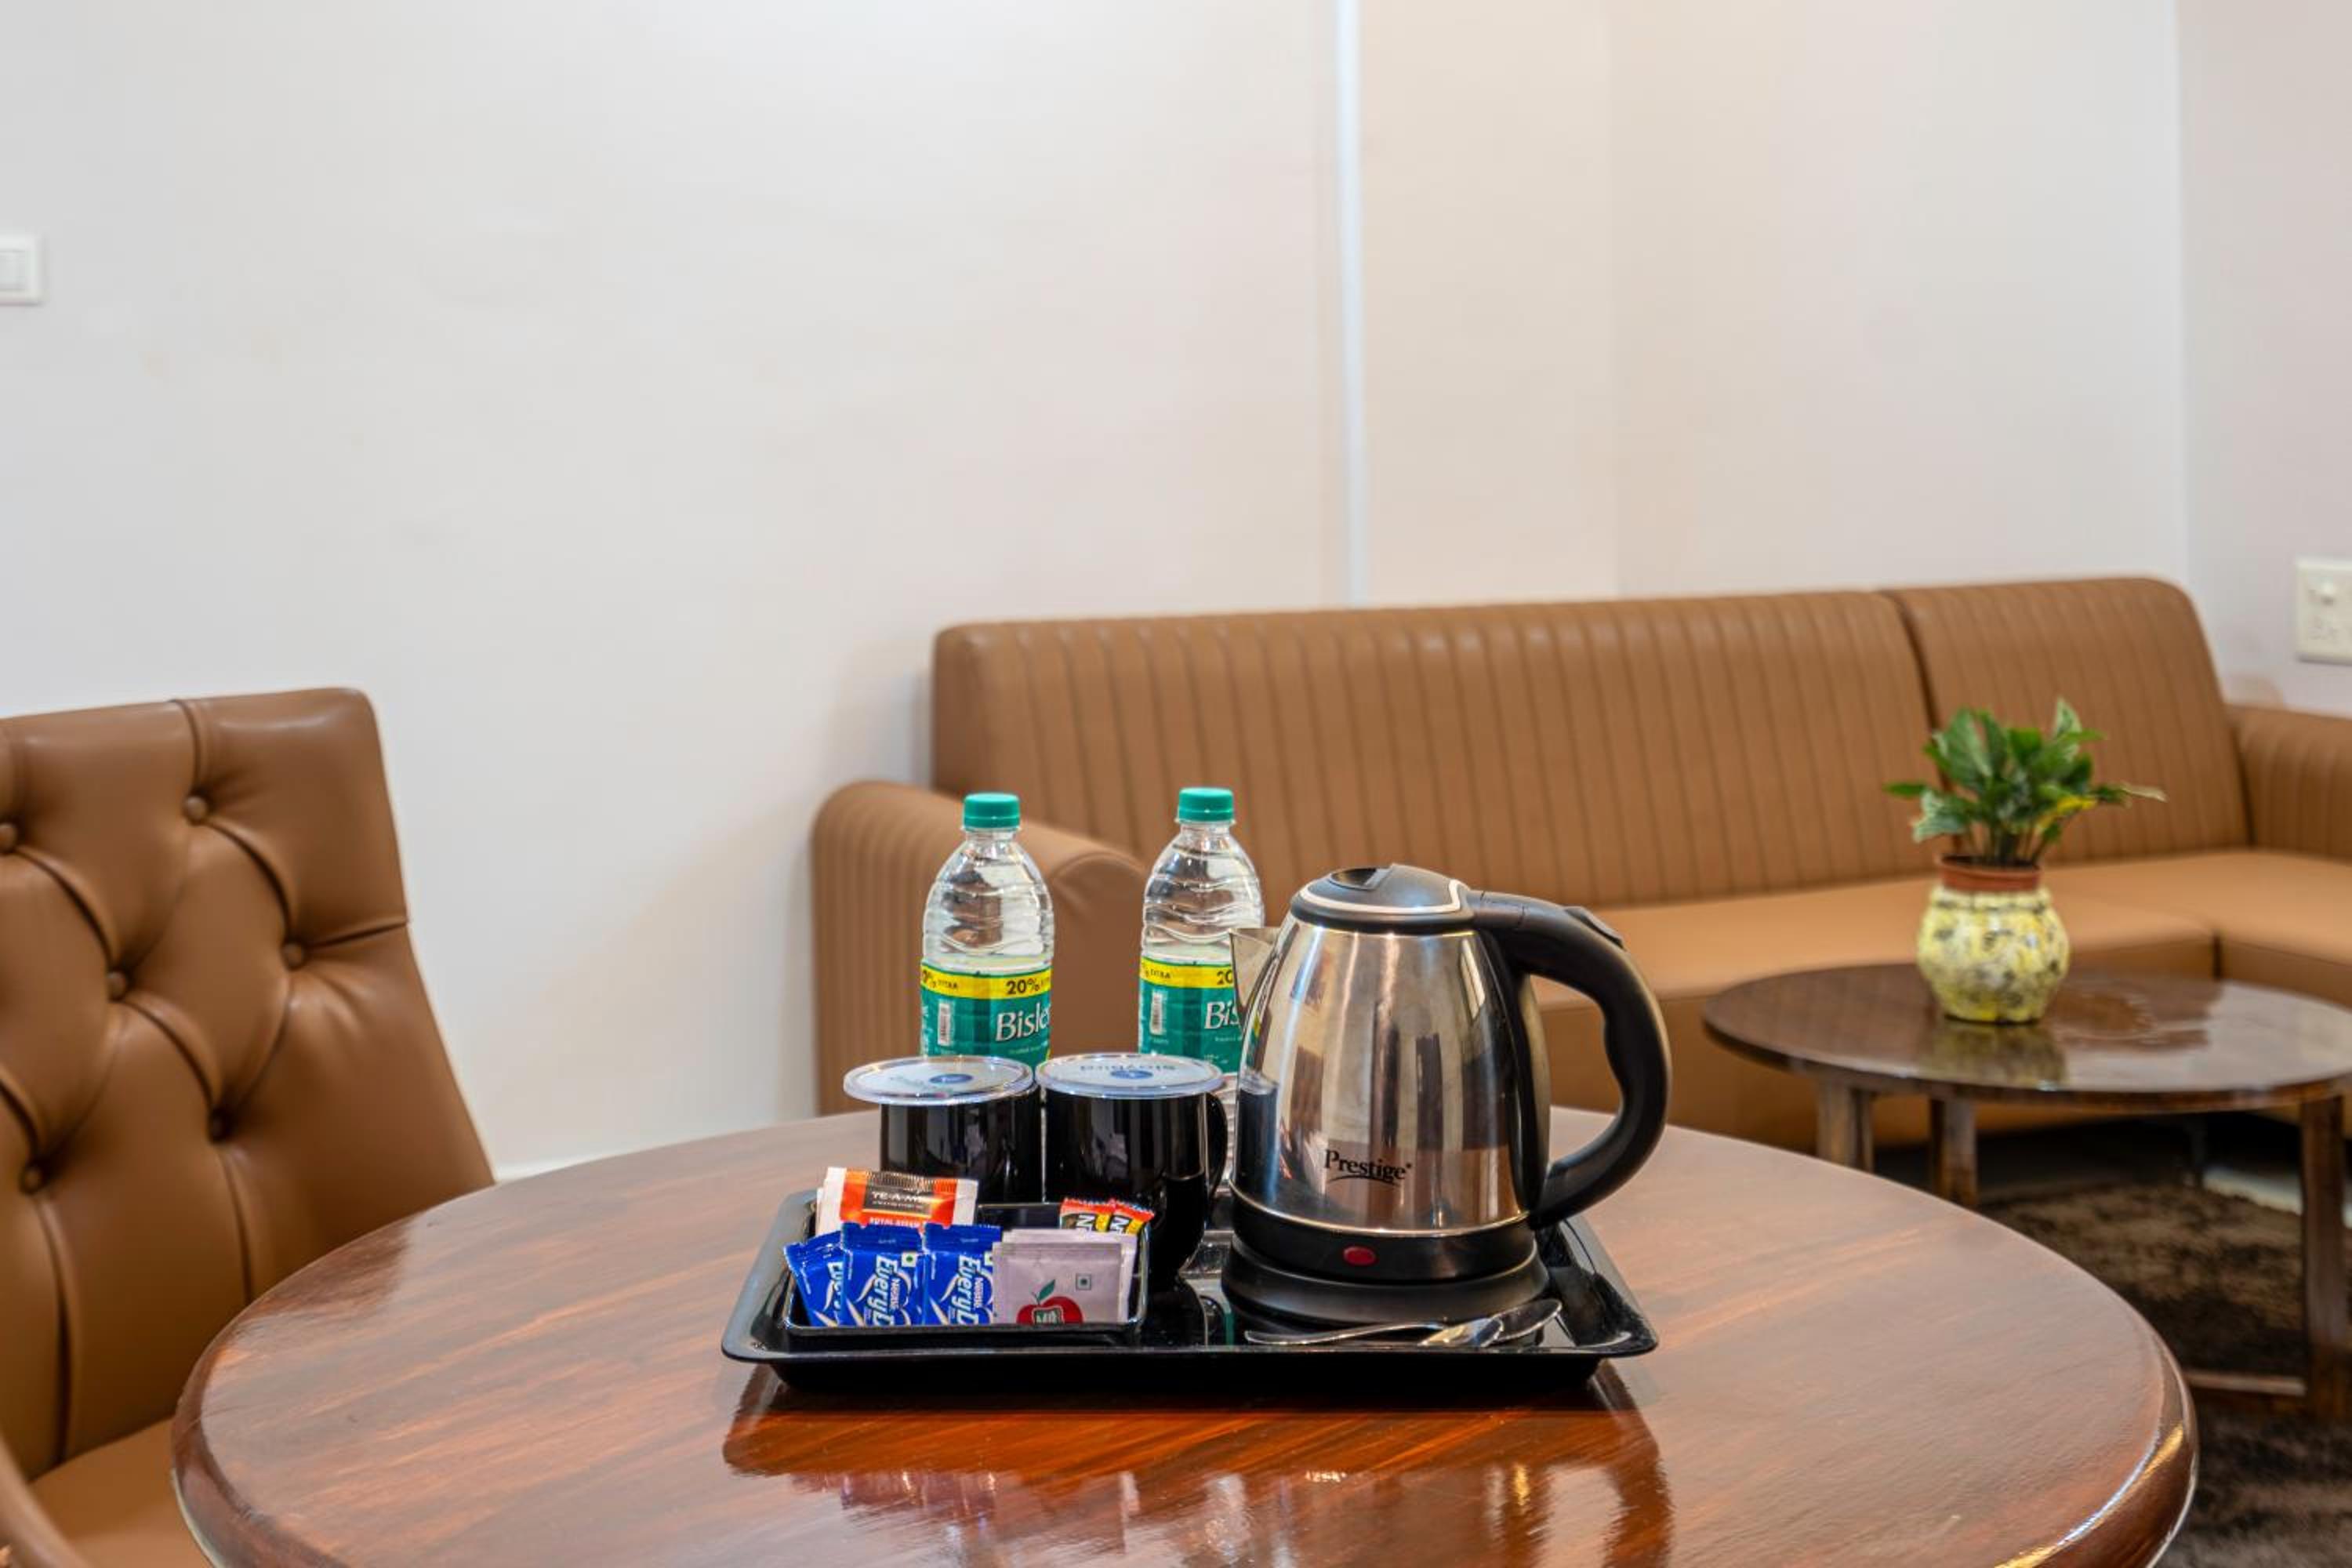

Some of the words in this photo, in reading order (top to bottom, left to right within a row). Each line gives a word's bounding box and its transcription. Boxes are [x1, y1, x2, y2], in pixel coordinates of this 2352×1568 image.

[1216, 969, 1234, 985] 20
[1006, 978, 1041, 995] 20%
[1324, 1149, 1406, 1184] Prestige
